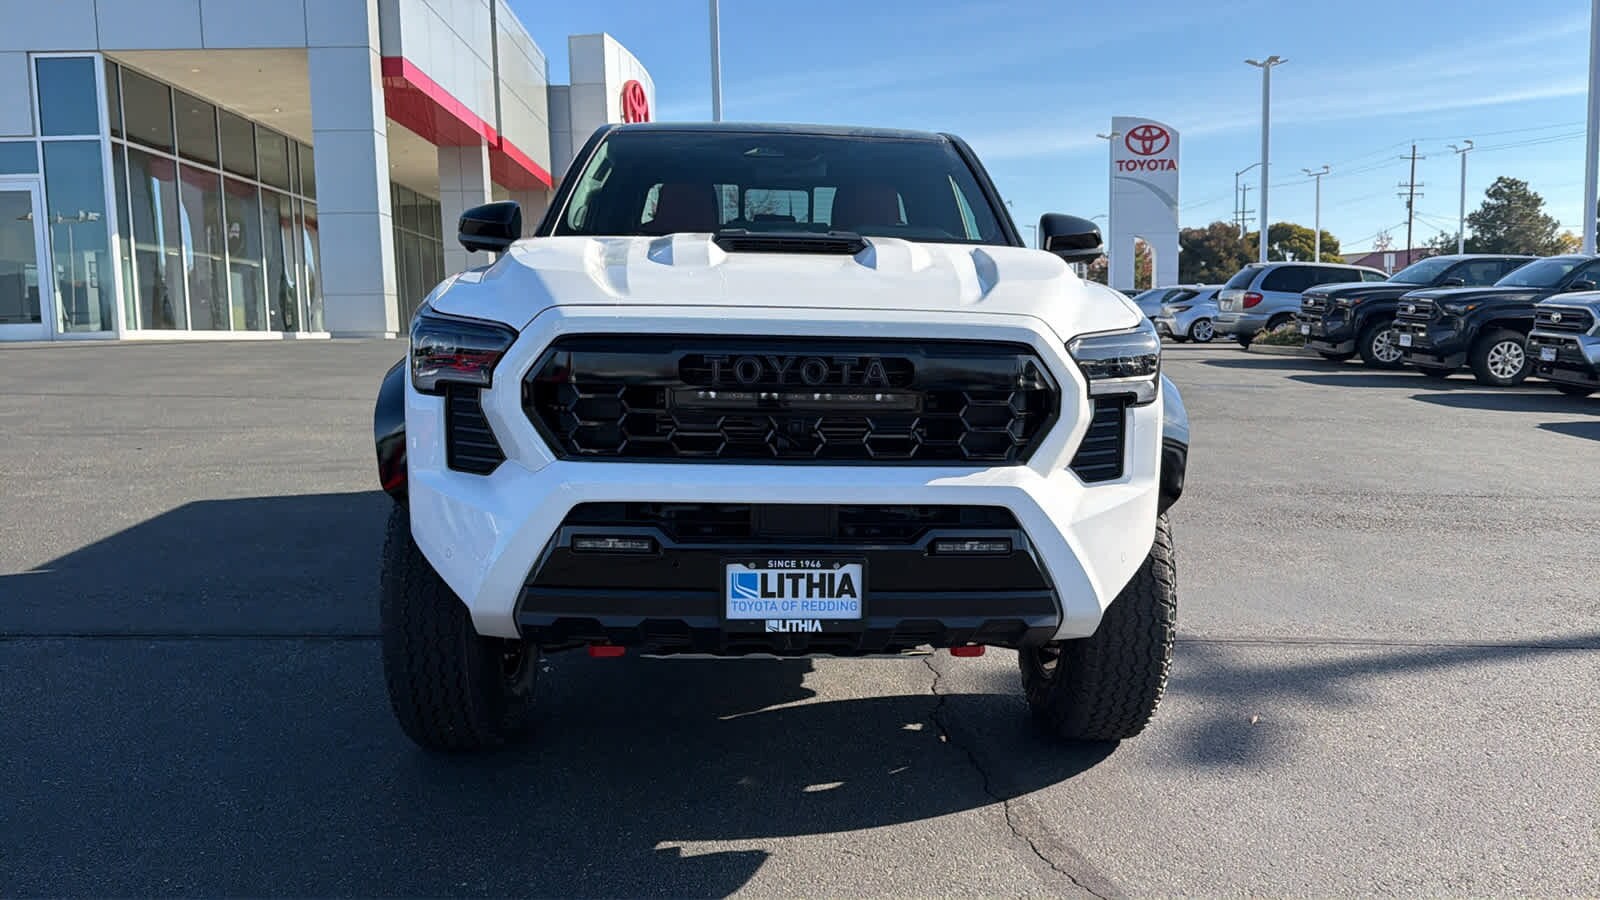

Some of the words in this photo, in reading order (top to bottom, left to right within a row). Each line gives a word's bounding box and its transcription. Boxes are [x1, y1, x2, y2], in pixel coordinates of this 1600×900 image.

[1115, 159, 1177, 172] TOYOTA
[703, 355, 889, 386] TOYOTA
[767, 560, 797, 568] SINCE
[799, 560, 822, 568] 1946
[760, 572, 857, 598] LITHIA
[732, 600, 778, 611] TOYOTA
[781, 600, 798, 611] OF
[801, 600, 857, 611] REDDING
[778, 619, 822, 632] LITHIA
